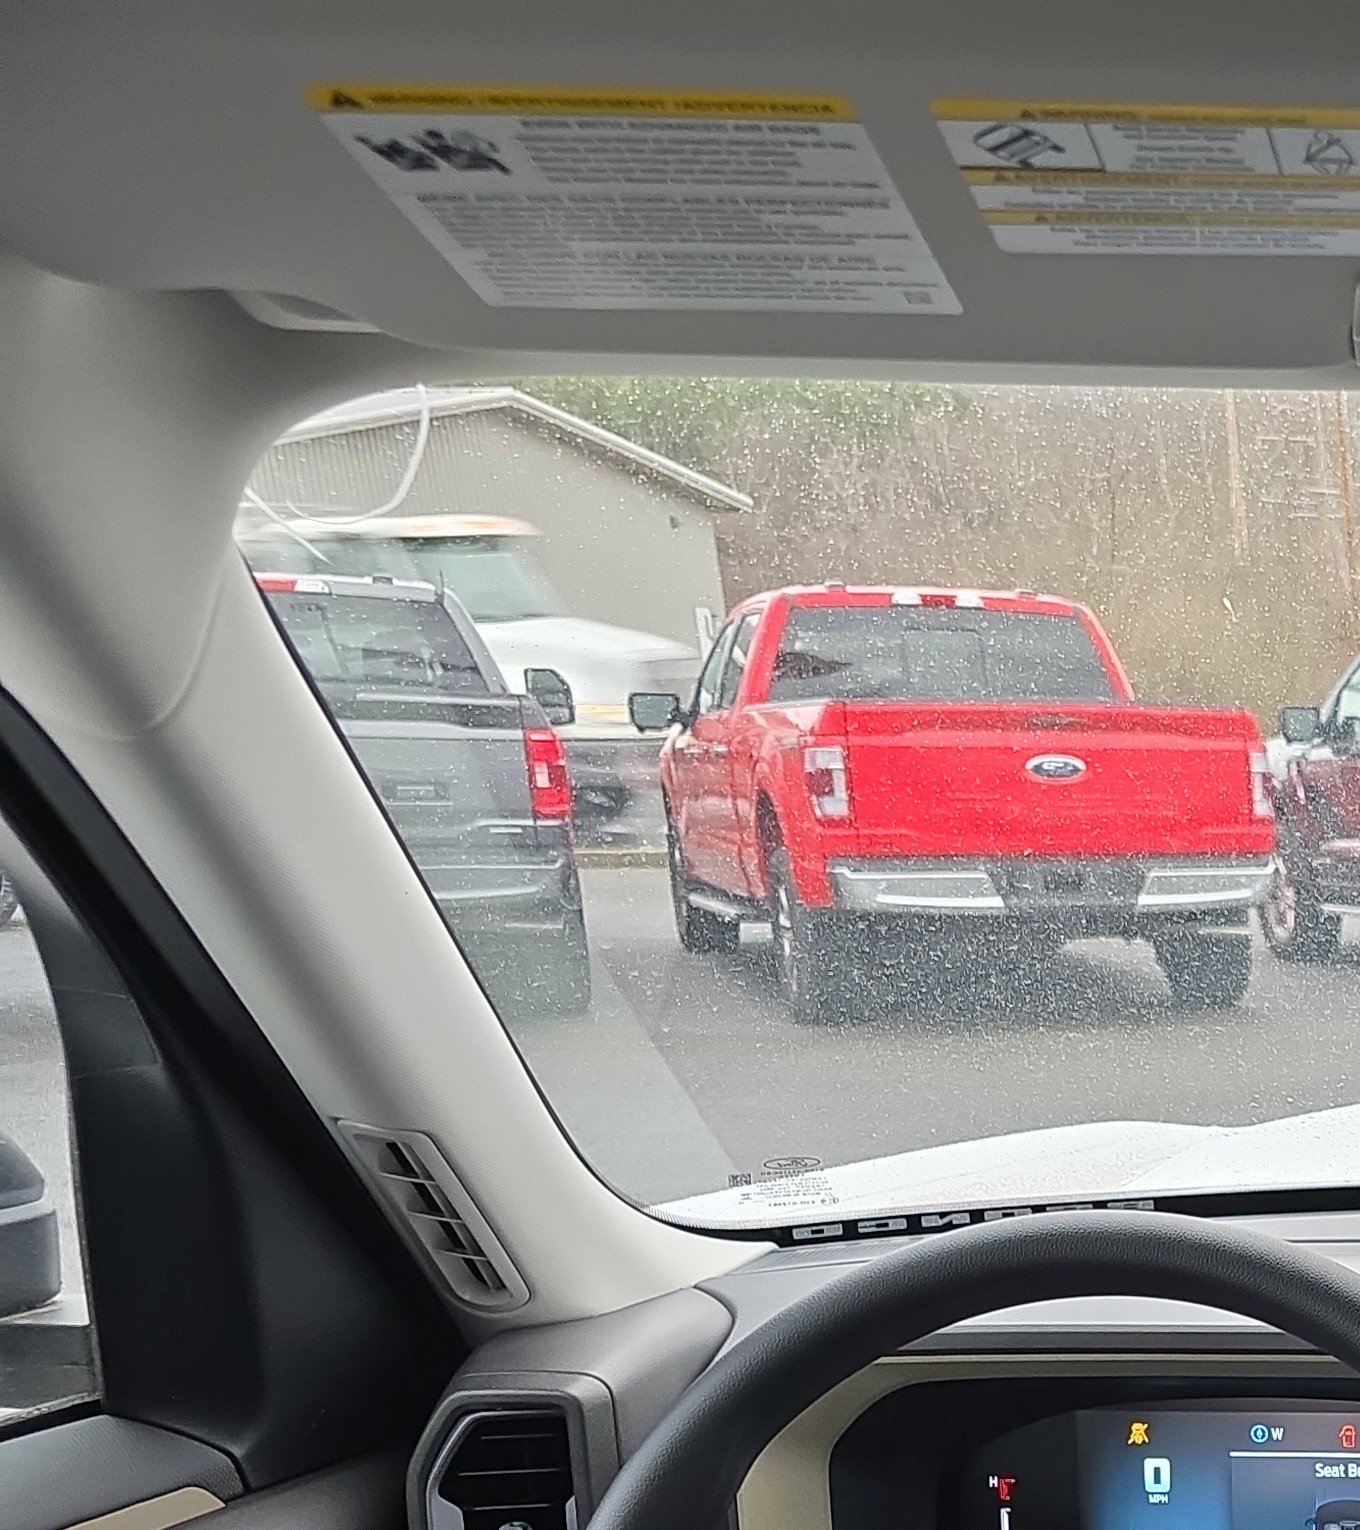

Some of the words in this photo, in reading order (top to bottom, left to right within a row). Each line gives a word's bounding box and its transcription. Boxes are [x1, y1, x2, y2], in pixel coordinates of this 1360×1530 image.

[1270, 1427, 1284, 1441] W
[1143, 1457, 1171, 1493] 0
[1314, 1463, 1346, 1478] Seat
[988, 1476, 998, 1488] H
[1148, 1494, 1169, 1504] MPH
